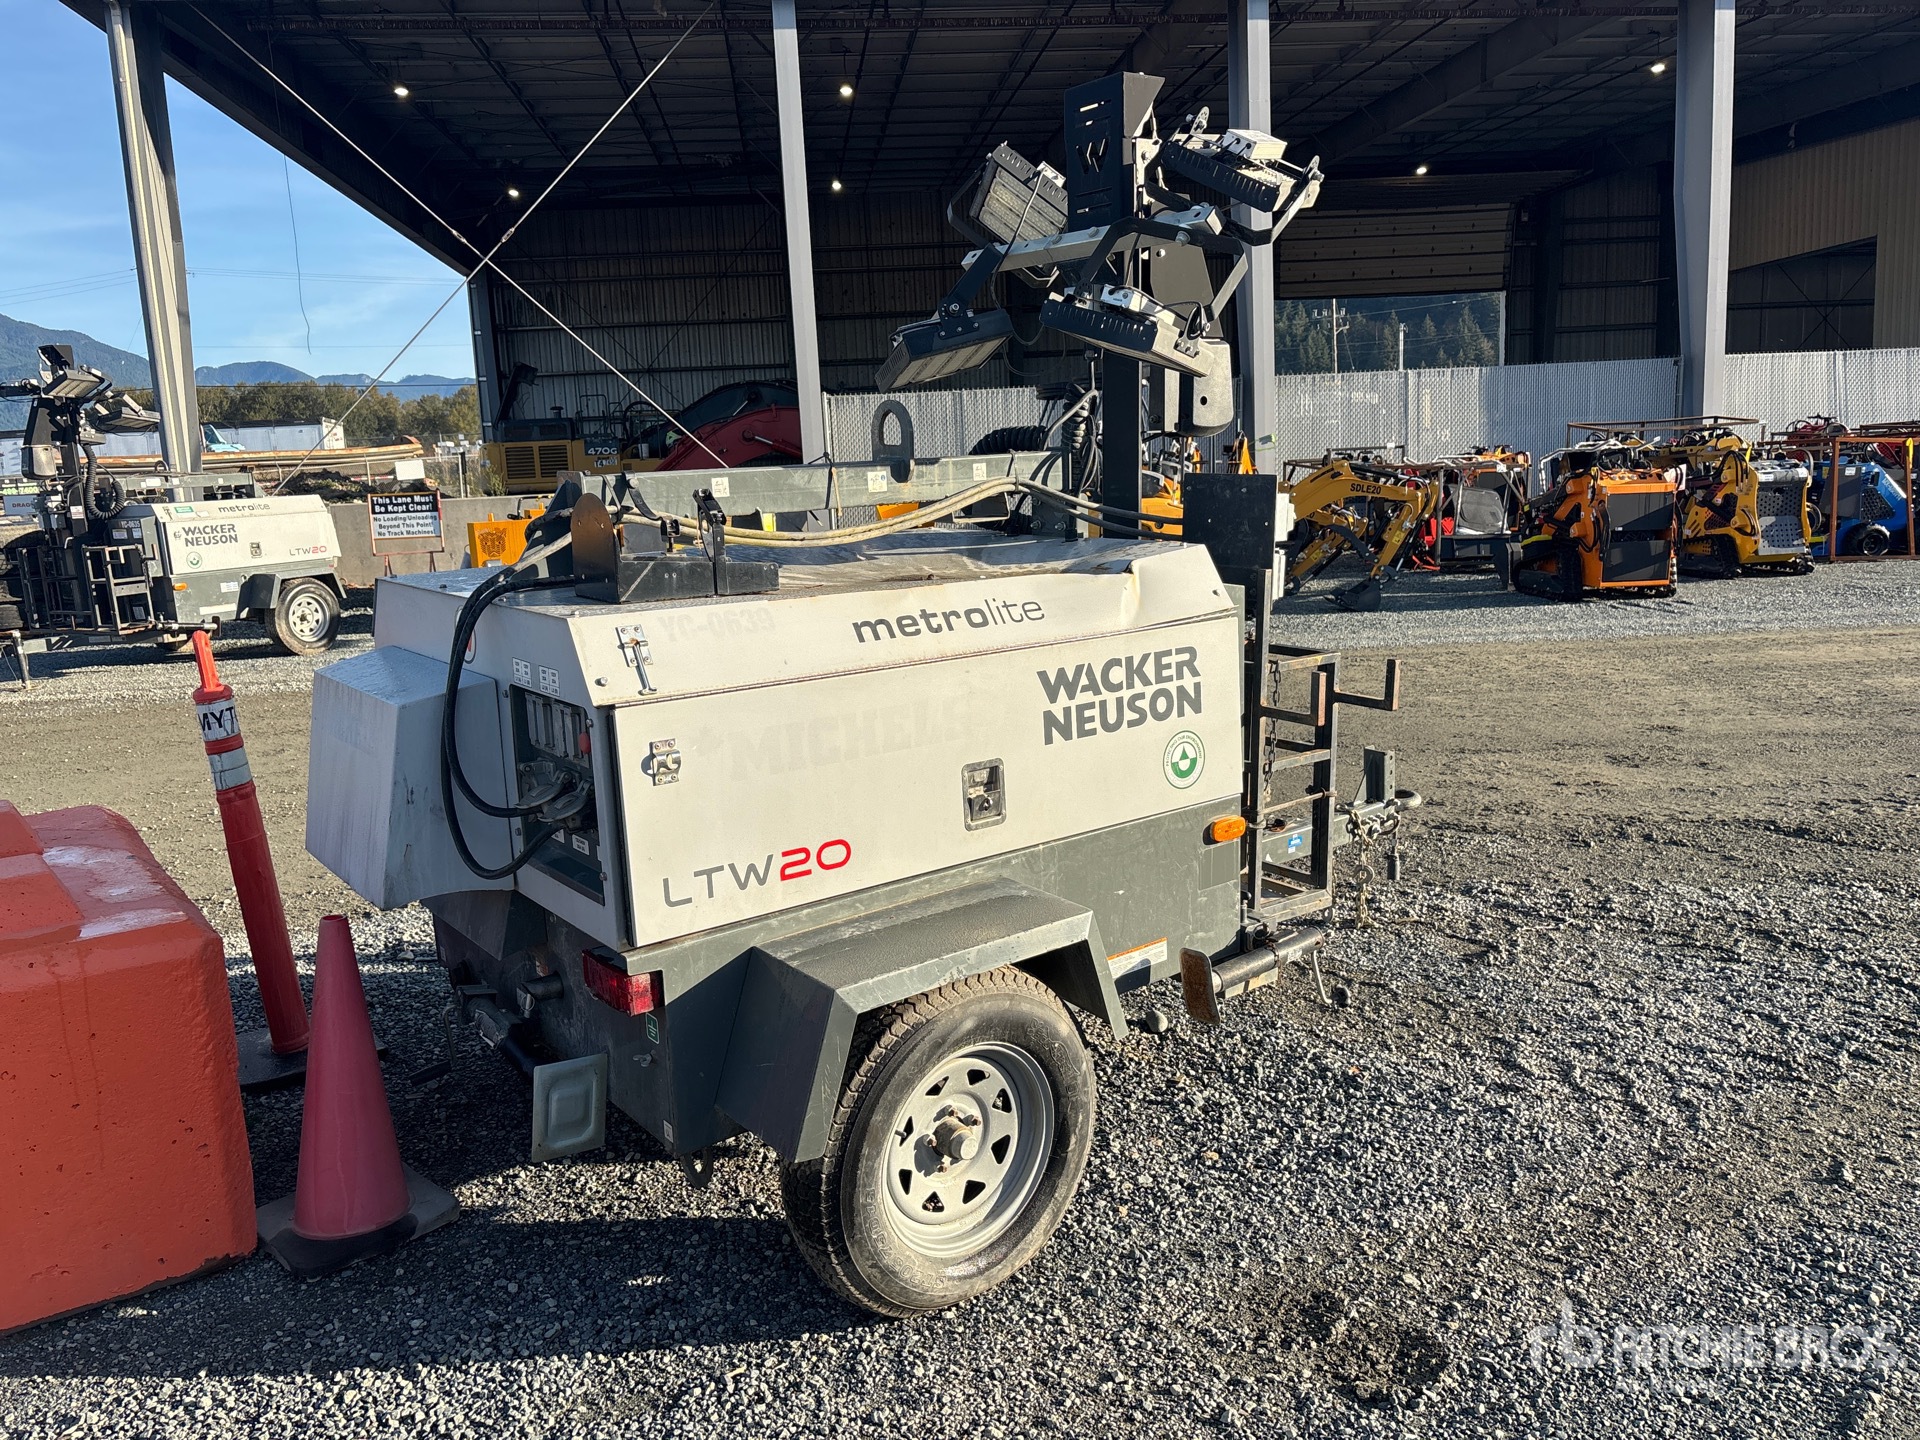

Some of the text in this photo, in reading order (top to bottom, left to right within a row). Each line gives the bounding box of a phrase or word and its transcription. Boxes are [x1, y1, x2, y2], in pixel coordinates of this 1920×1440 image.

[587, 447, 618, 455] 470G
[1350, 483, 1382, 495] SDLE20
[372, 495, 433, 504] This Lane Must
[218, 502, 271, 514] metrolite
[387, 504, 406, 513] Kept
[408, 503, 433, 511] Clear!
[182, 523, 237, 538] WACKER
[378, 523, 400, 531] Beyond
[184, 533, 238, 547] NEUSON
[289, 545, 327, 556] LTW20
[852, 598, 1045, 643] metrolite
[1036, 646, 1201, 704] WACKER
[1043, 681, 1202, 746] NEUSON
[662, 838, 852, 908] LTW20
